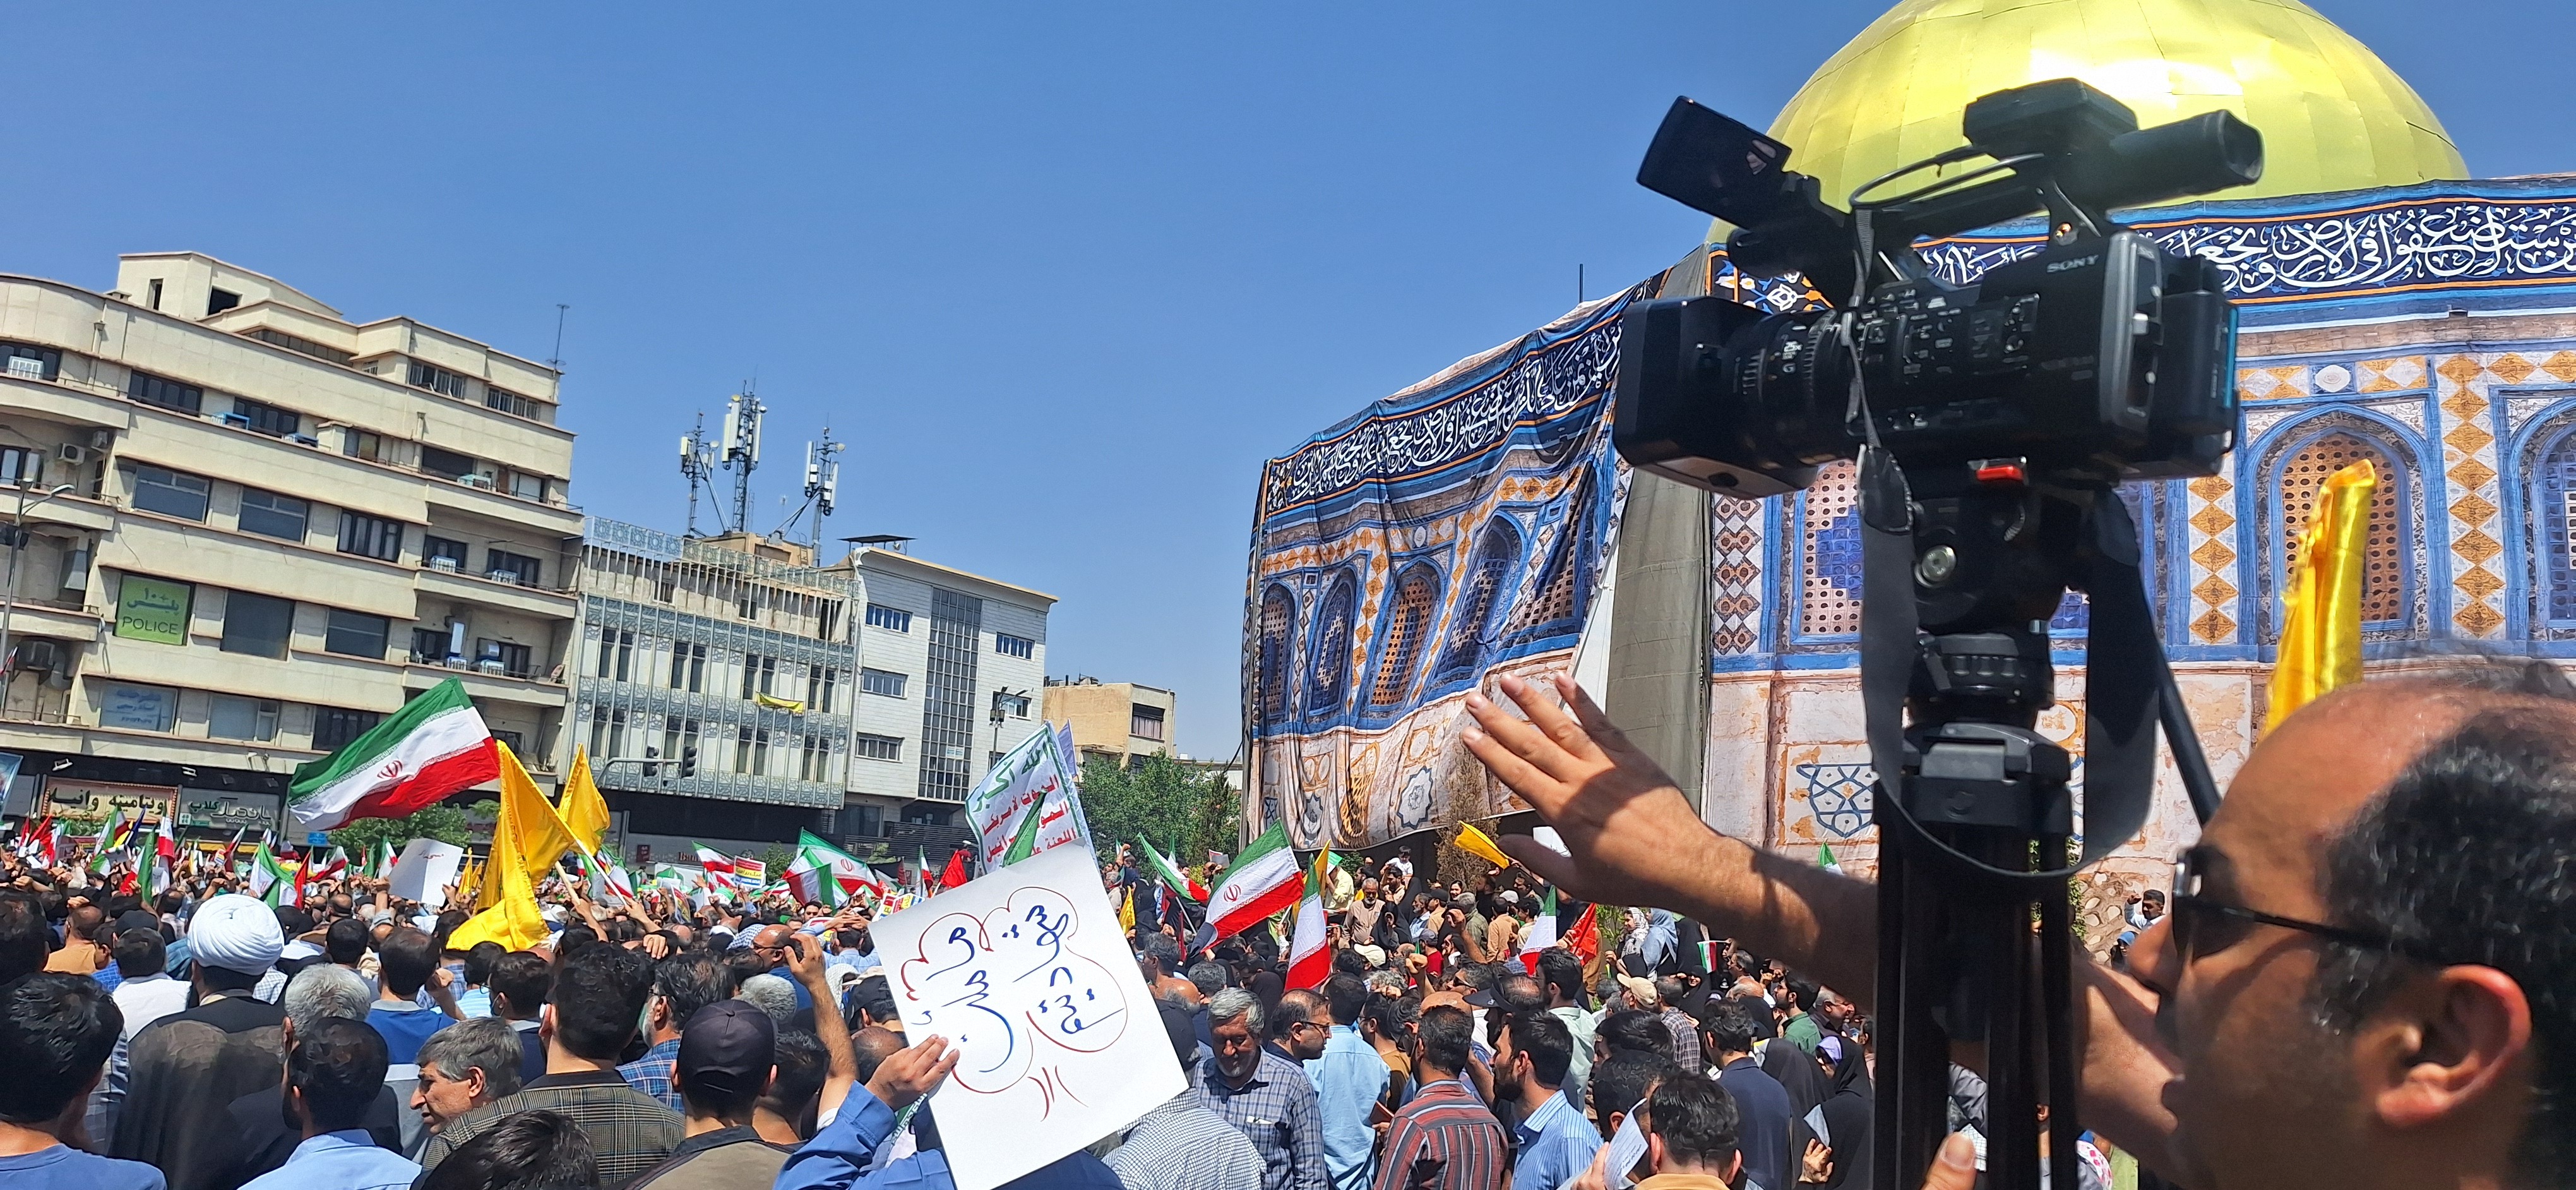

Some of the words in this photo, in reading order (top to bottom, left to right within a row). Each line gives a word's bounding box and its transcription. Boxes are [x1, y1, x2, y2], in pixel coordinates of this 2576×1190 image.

[2046, 254, 2099, 273] SONY
[122, 616, 179, 635] POLICE
[1037, 800, 1069, 829] المو
